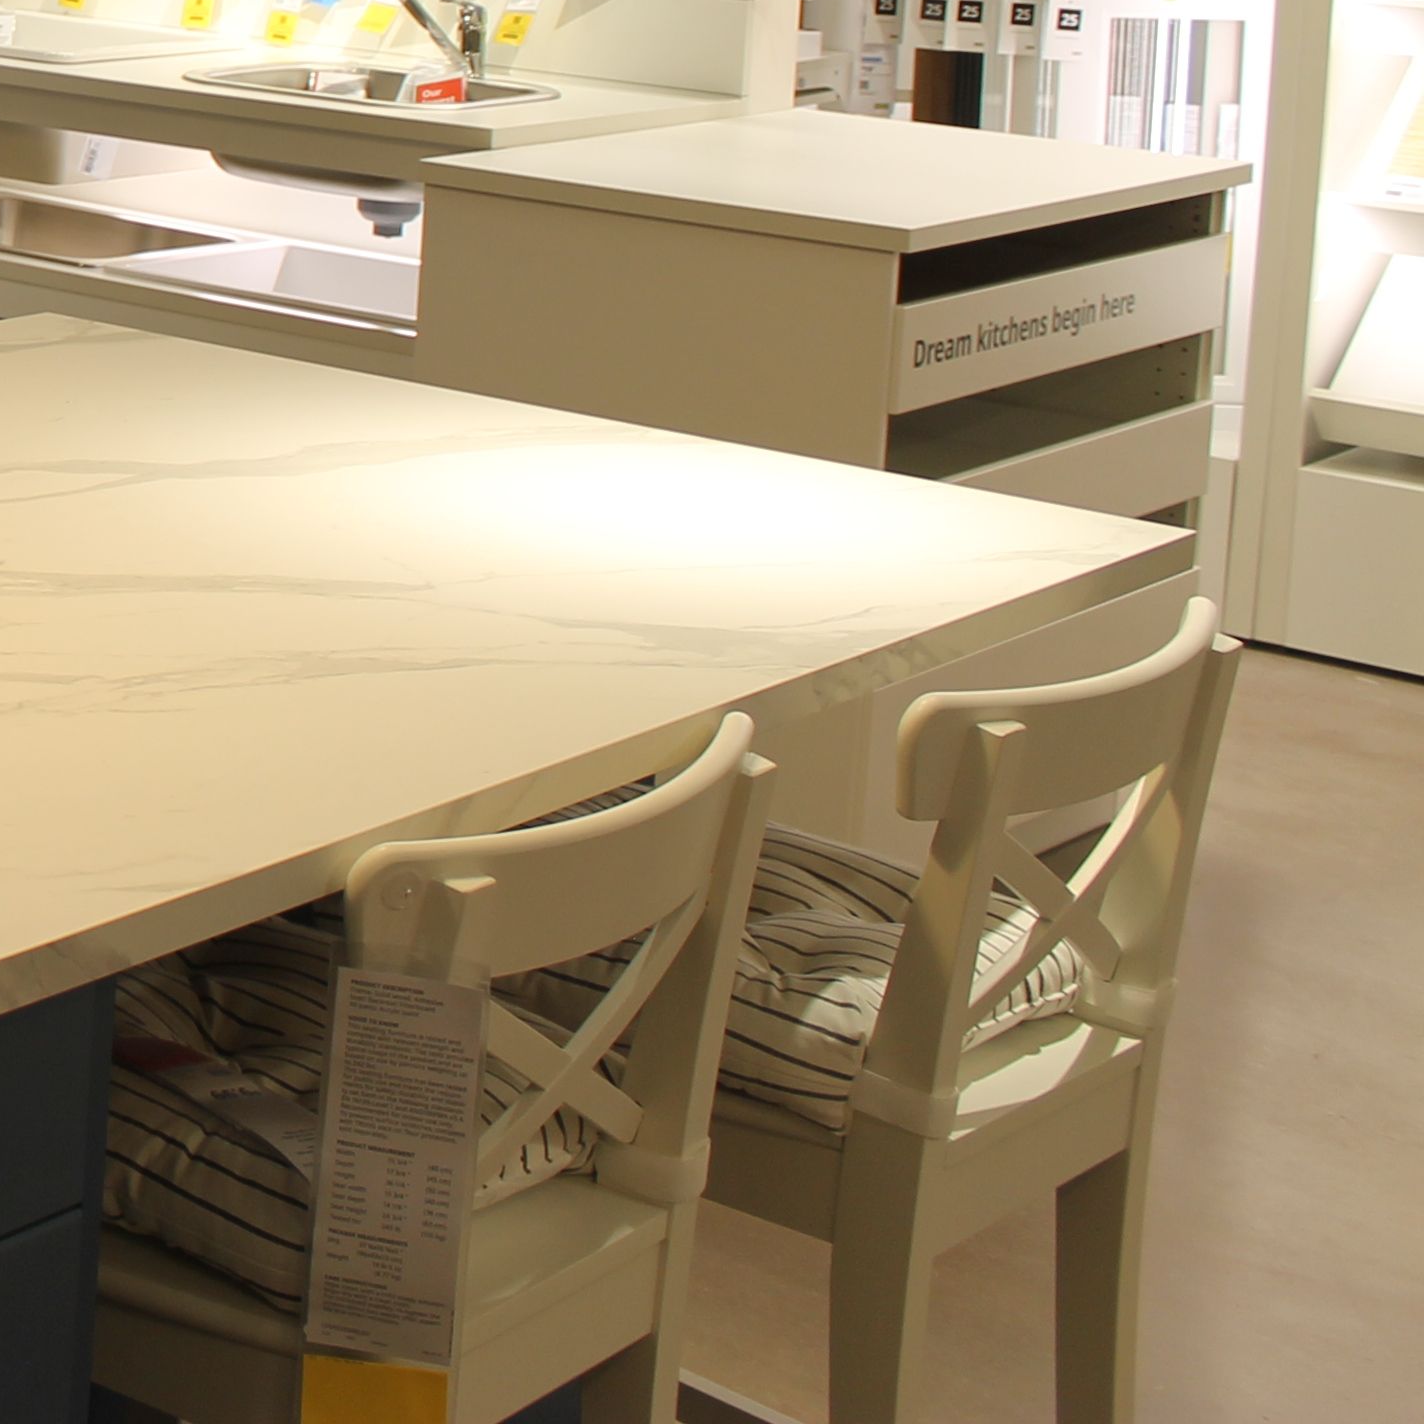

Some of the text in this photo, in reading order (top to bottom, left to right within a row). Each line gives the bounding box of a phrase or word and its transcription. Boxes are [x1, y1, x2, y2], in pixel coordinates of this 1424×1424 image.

[924, 3, 943, 17] 25
[961, 5, 980, 19] 25
[1015, 7, 1033, 22] 25
[1059, 13, 1078, 27] 25
[913, 293, 1136, 368] Dream kitchens begin here
